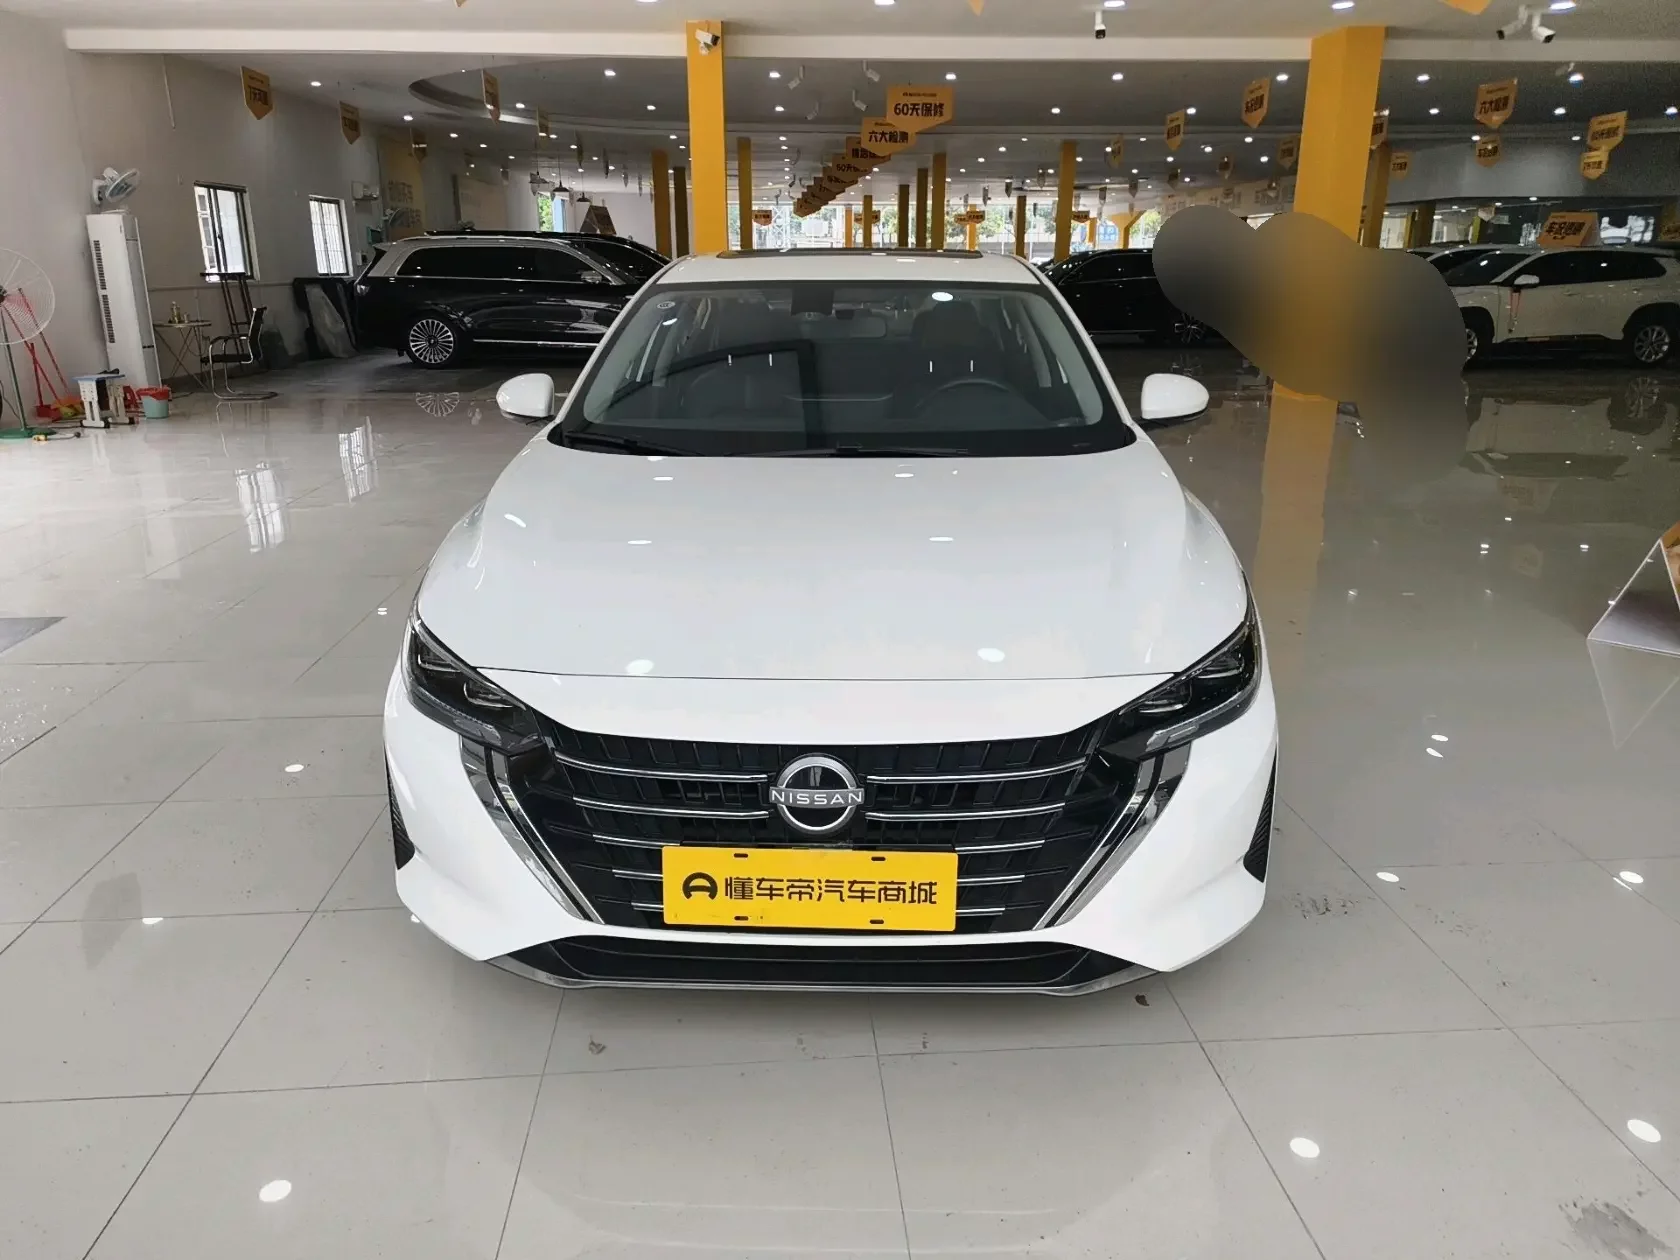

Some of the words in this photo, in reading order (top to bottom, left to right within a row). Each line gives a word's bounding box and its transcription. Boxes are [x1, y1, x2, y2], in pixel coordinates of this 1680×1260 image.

[894, 102, 945, 118] 60天保修
[868, 129, 909, 144] 六大检测
[771, 789, 862, 805] NISSAN
[724, 876, 938, 905] 懂车帝汽车商城
